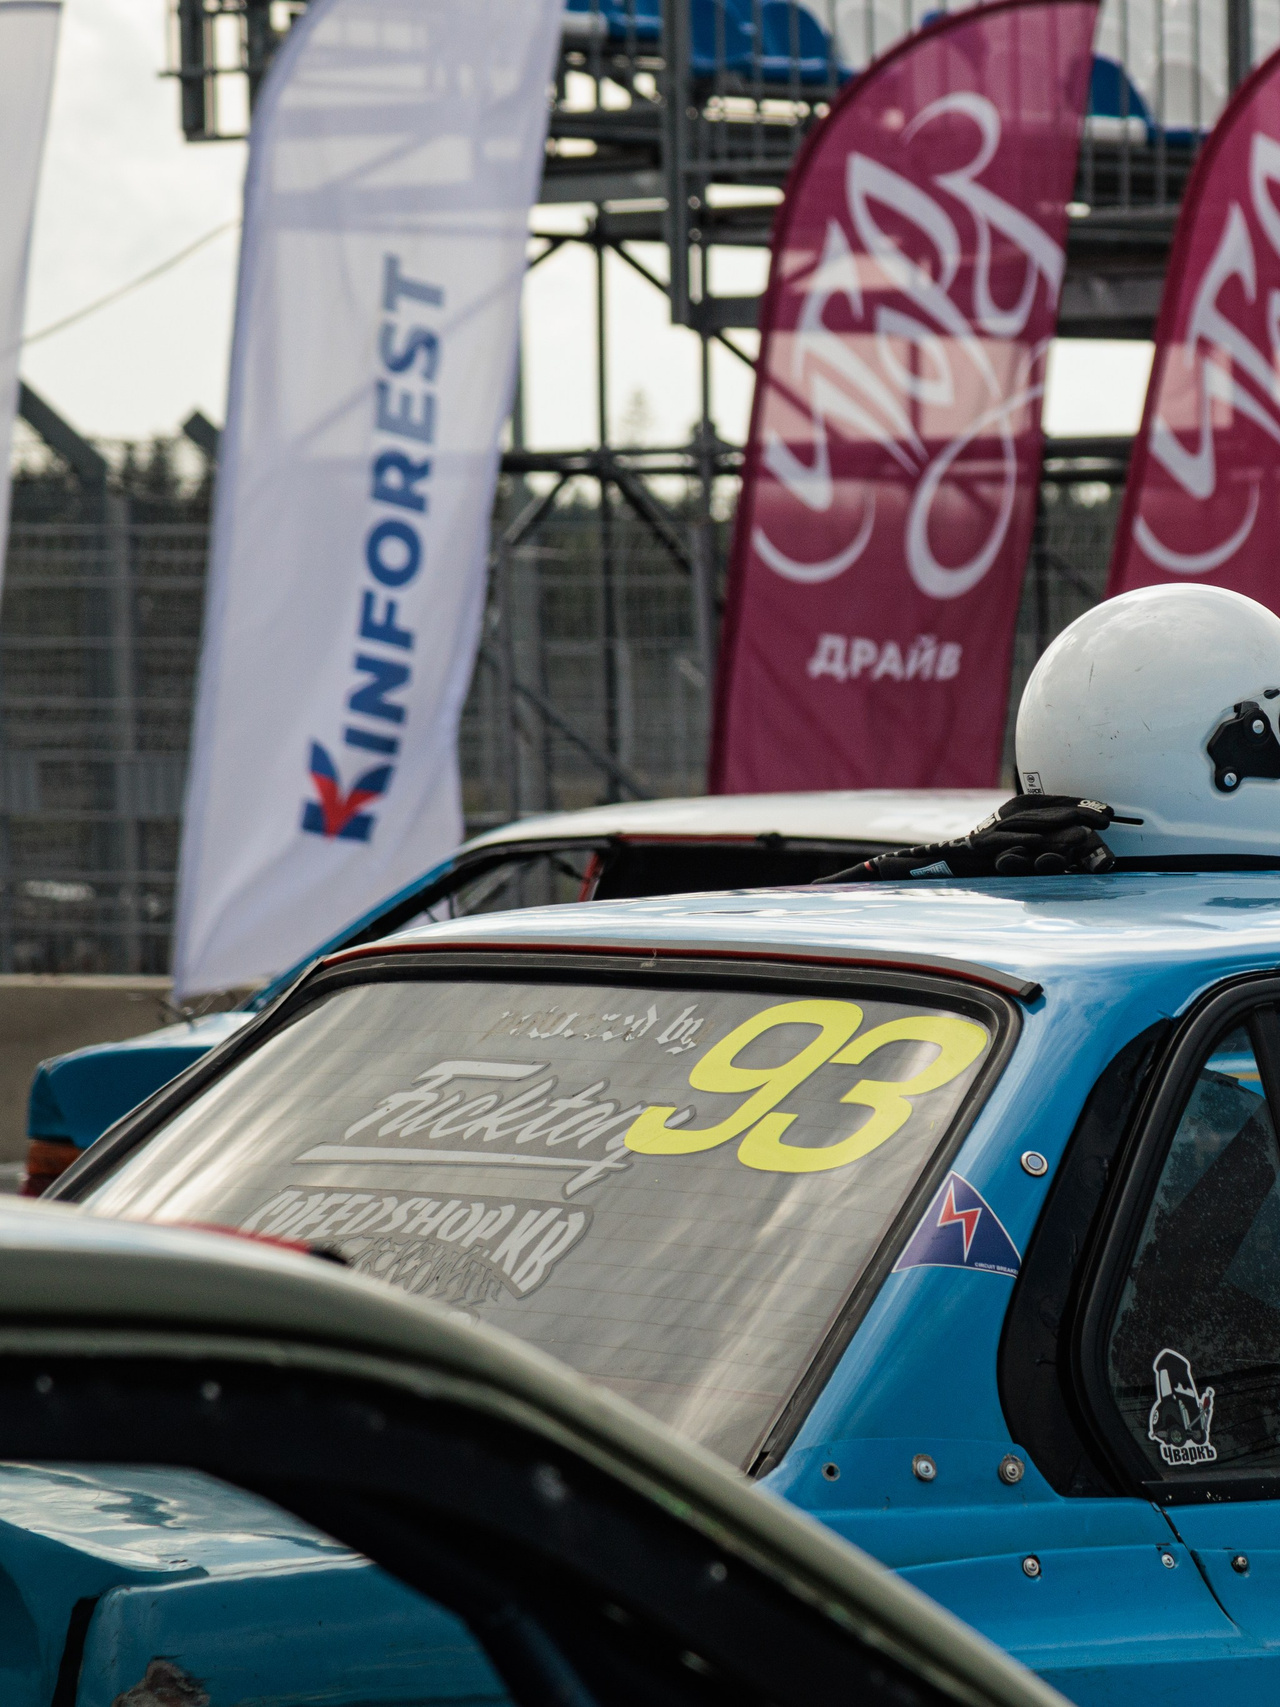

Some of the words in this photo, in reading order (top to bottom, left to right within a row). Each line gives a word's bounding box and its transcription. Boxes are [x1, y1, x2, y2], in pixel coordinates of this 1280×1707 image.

[300, 252, 446, 845] KINFOREST
[807, 633, 962, 683] ДРАЙВ
[622, 999, 989, 1173] 93
[1162, 1446, 1215, 1463] Чваркъ
